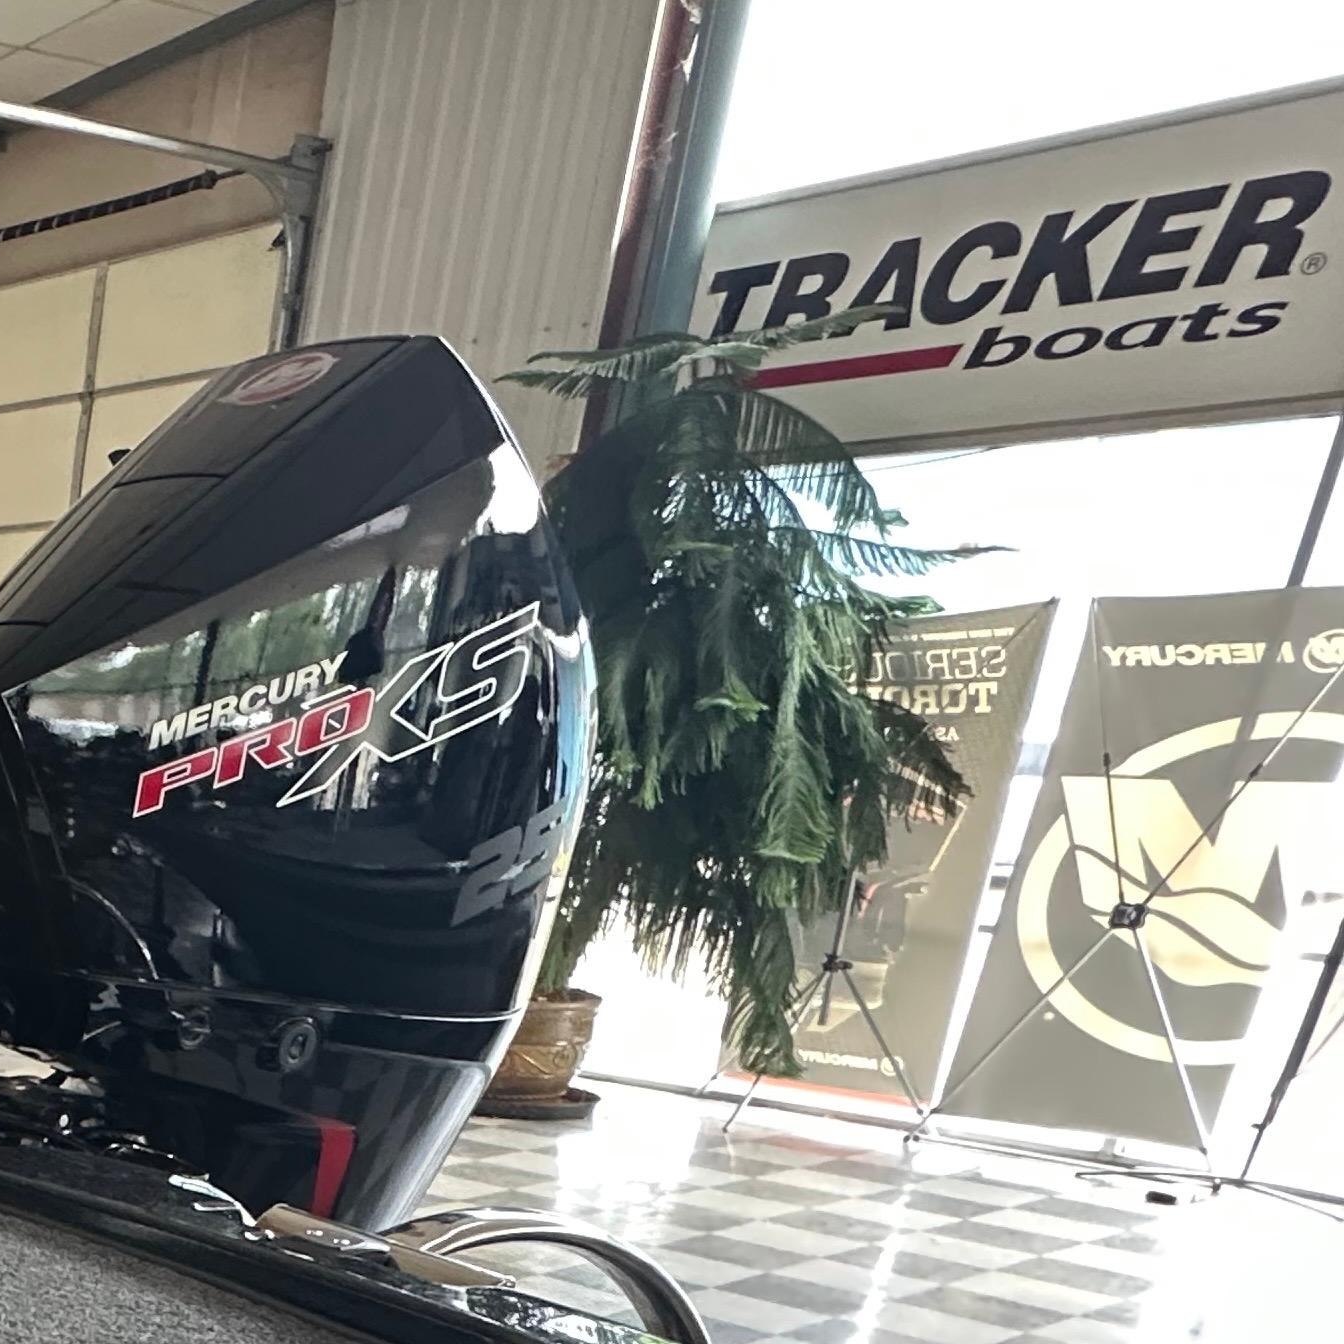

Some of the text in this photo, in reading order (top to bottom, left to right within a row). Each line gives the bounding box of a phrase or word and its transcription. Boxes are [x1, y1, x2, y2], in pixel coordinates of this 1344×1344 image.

[708, 170, 1331, 343] TRACKER
[962, 301, 1290, 371] boats
[132, 685, 375, 818] PRO
[148, 651, 348, 750] MERCURY
